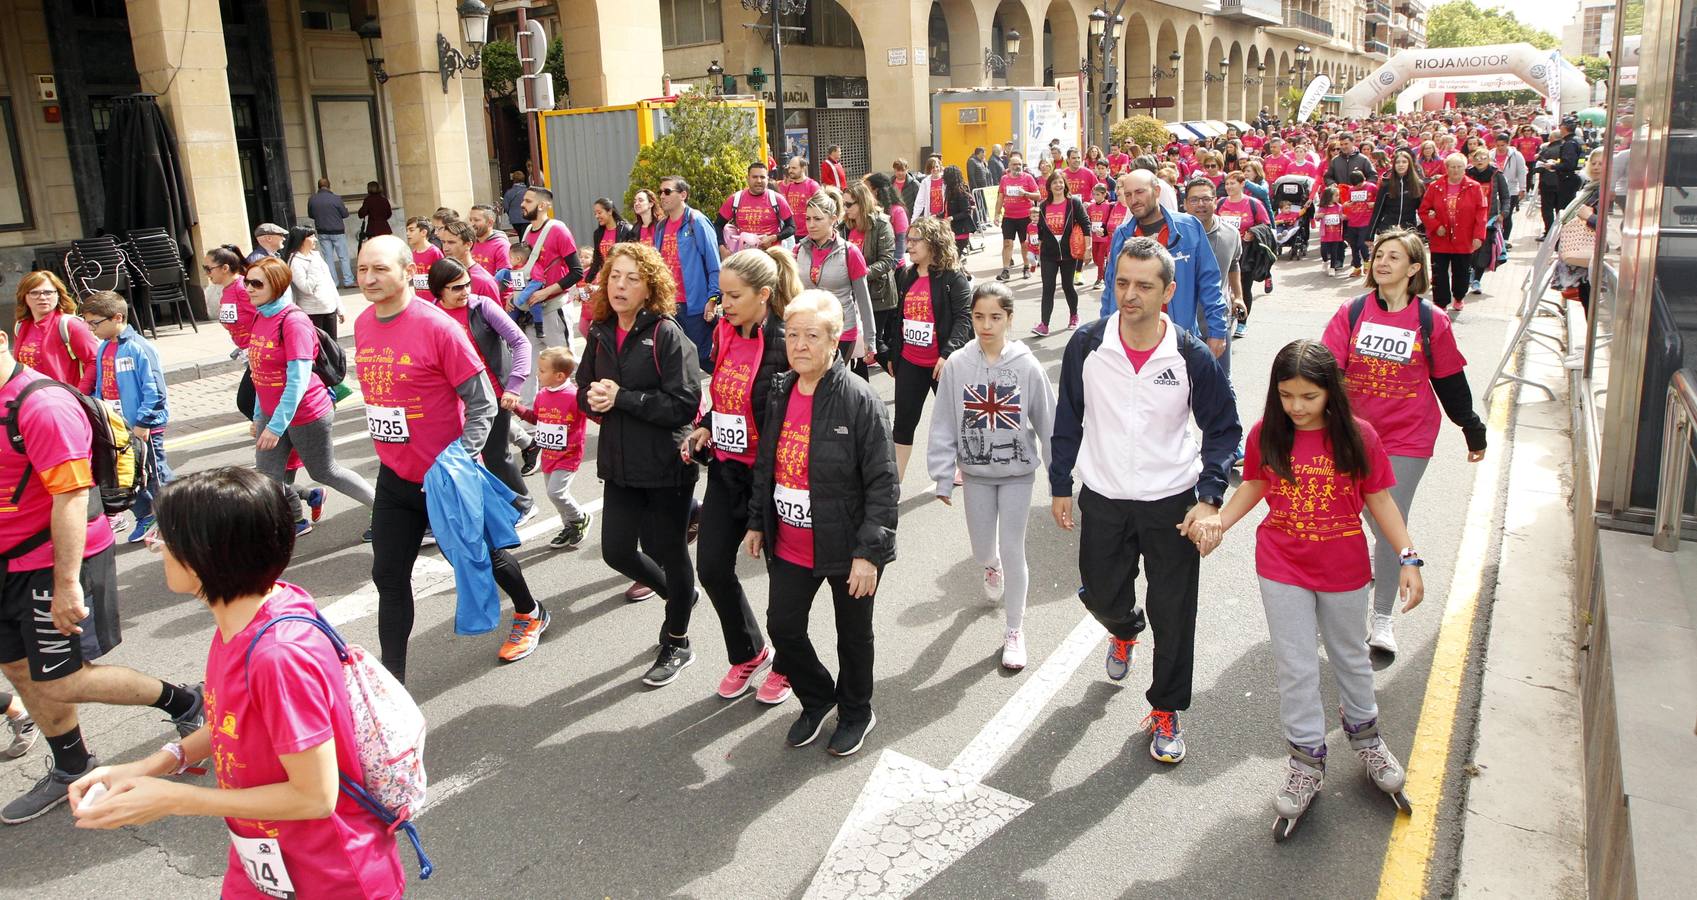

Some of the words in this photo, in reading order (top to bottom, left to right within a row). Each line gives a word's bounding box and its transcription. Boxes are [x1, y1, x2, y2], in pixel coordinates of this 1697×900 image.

[1415, 54, 1509, 70] RIOJAMOTOR
[762, 91, 810, 103] FAACIA
[904, 329, 930, 342] 4002
[1360, 334, 1408, 355] 4700
[1153, 378, 1181, 386] adidas
[368, 417, 404, 436] 3735
[535, 430, 564, 446] 3302
[715, 425, 745, 446] 0592
[1301, 463, 1336, 477] Familia
[32, 588, 72, 654] NIKE
